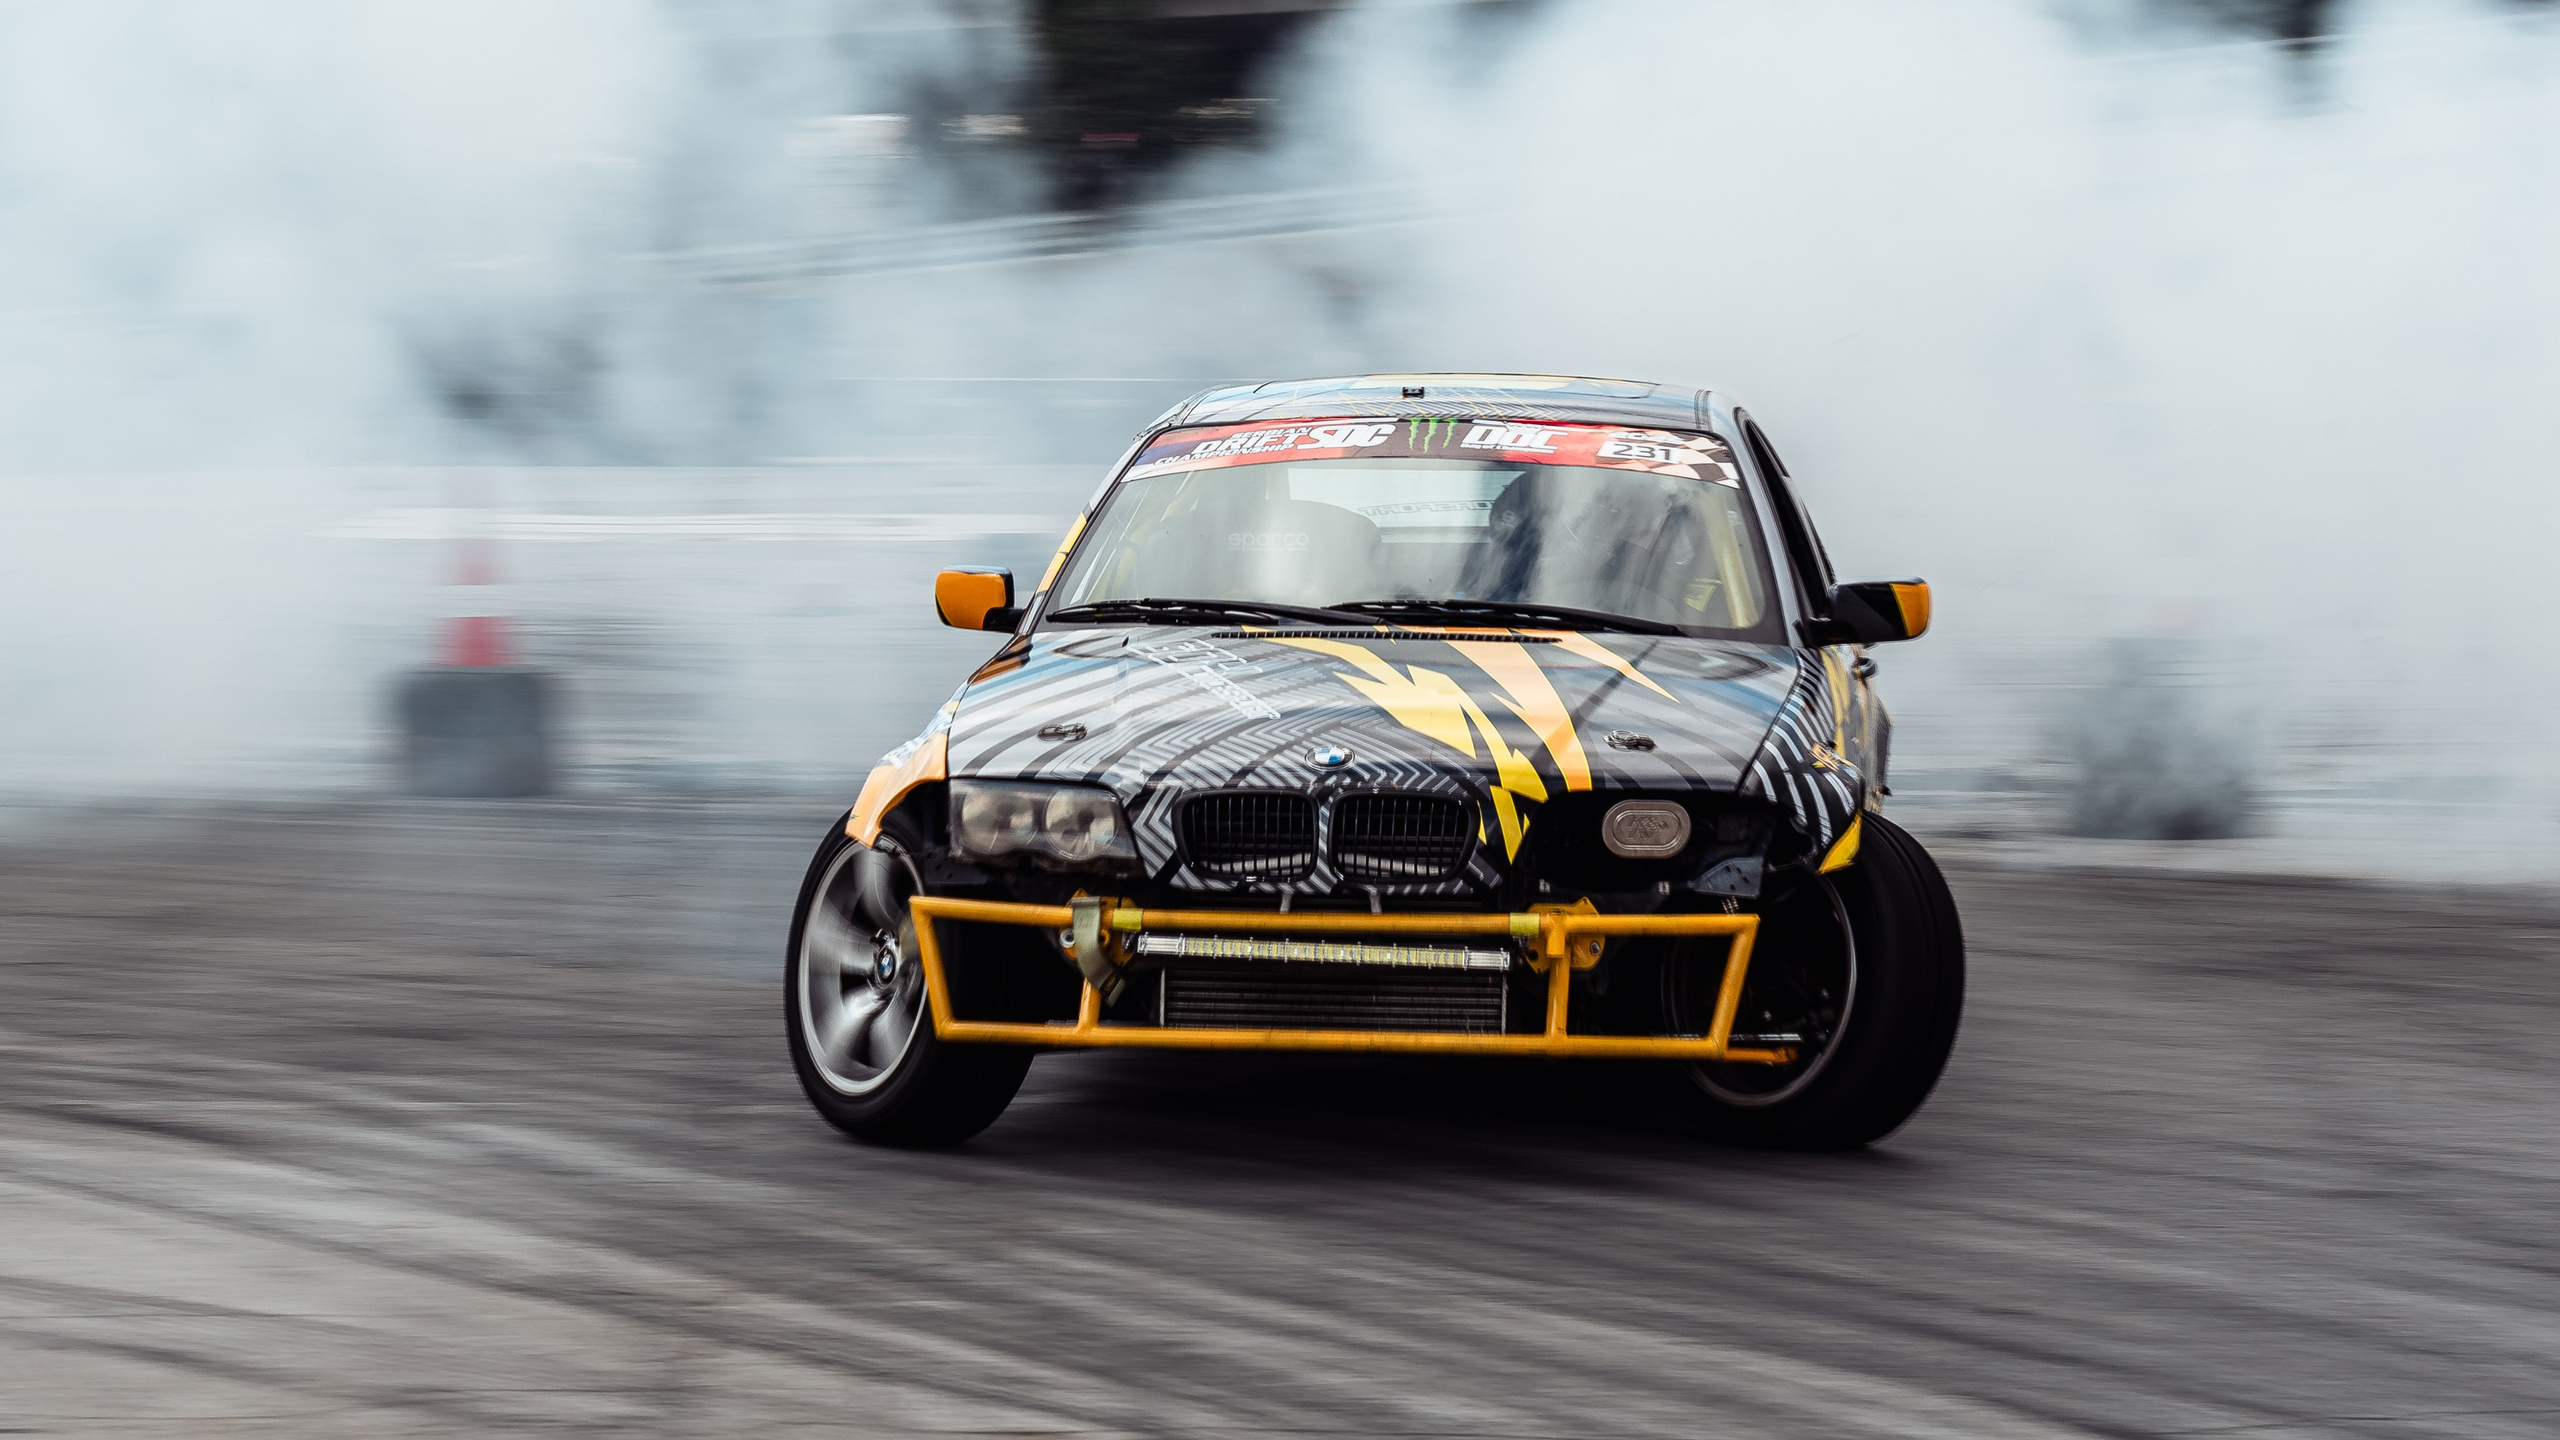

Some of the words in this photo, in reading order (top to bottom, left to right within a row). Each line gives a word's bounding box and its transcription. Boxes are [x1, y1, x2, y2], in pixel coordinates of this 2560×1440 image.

[1191, 432, 1308, 454] DRIFT
[1231, 427, 1313, 440] SERBIAN
[1297, 424, 1397, 449] SDC
[1153, 442, 1295, 466] CHAMPIONSHIP
[1613, 442, 1672, 461] 231
[1228, 531, 1310, 551] sparco
